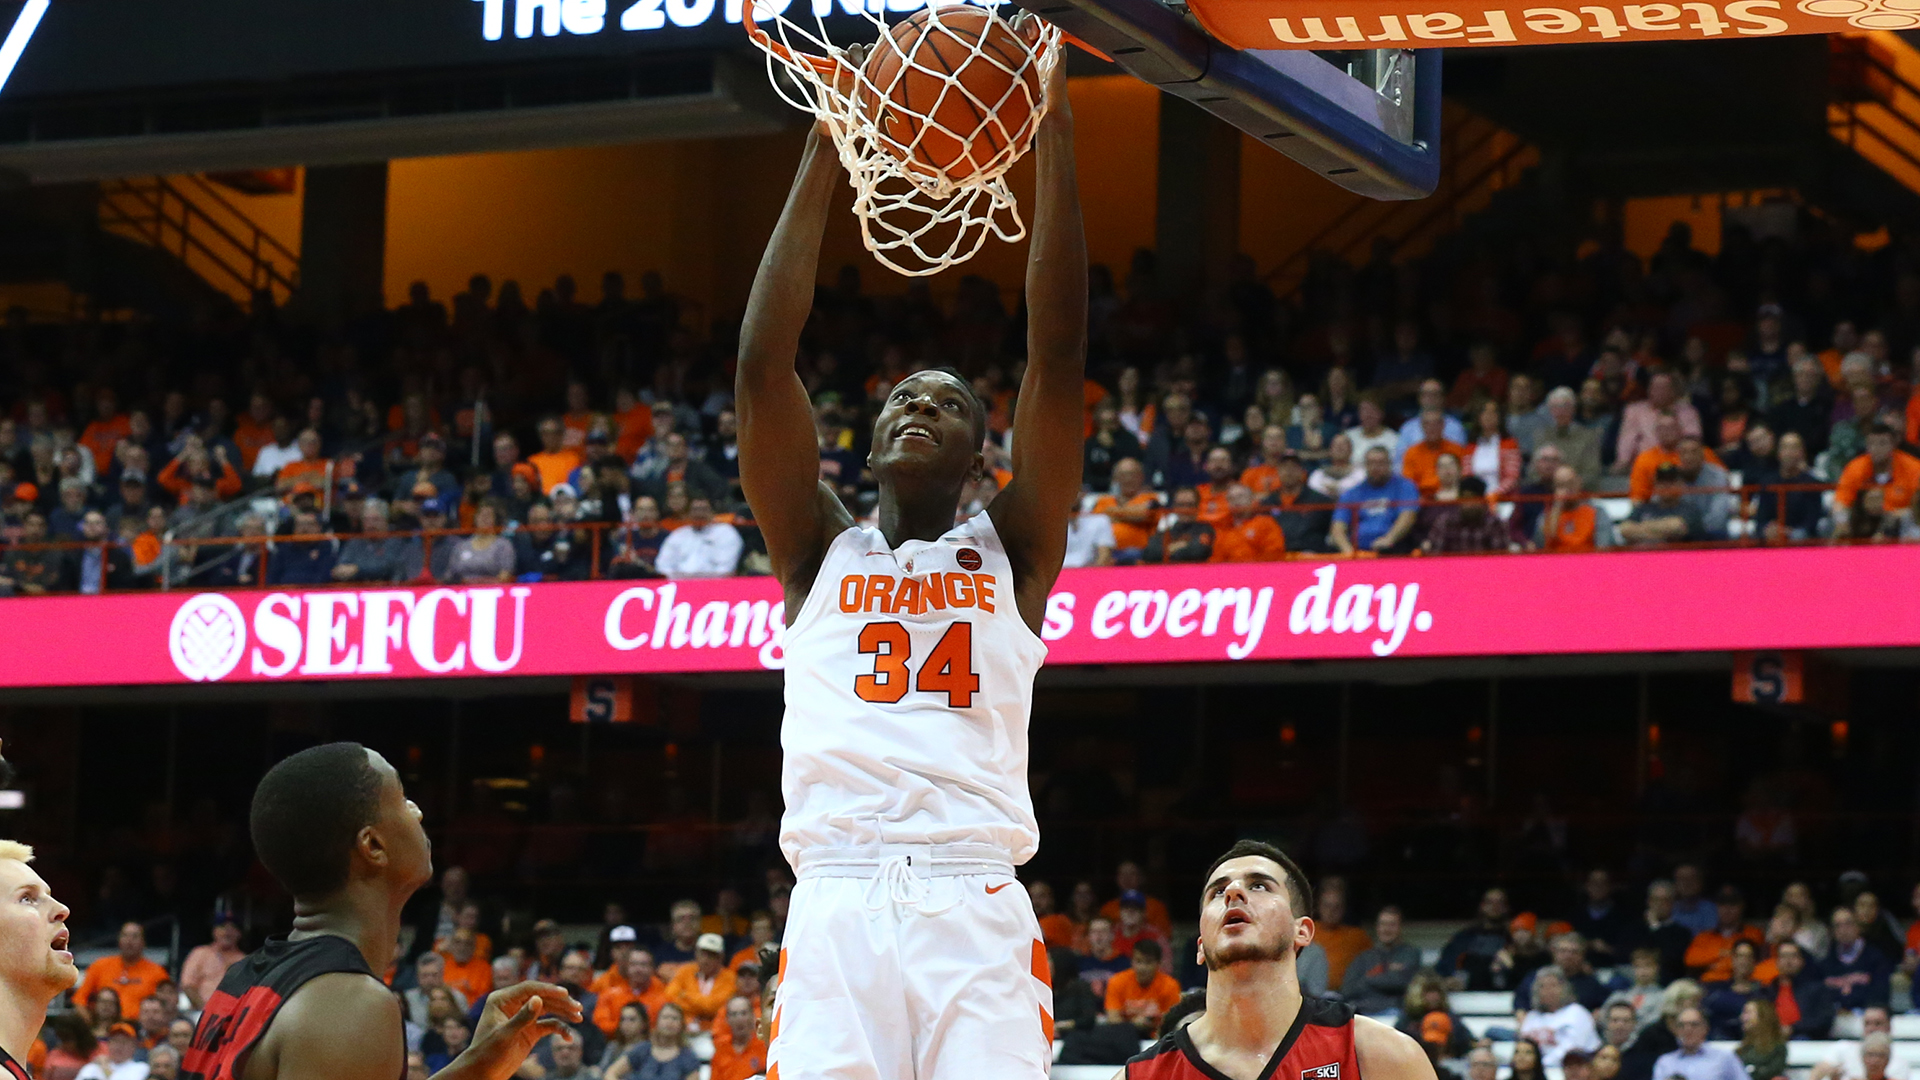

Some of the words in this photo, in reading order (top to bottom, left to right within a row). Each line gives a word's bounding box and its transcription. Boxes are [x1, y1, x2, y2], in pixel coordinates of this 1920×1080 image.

[251, 587, 532, 677] SEFCU
[1090, 586, 1274, 660] every
[1289, 563, 1433, 657] day.
[839, 572, 996, 615] ORANGE
[854, 621, 980, 708] 34
